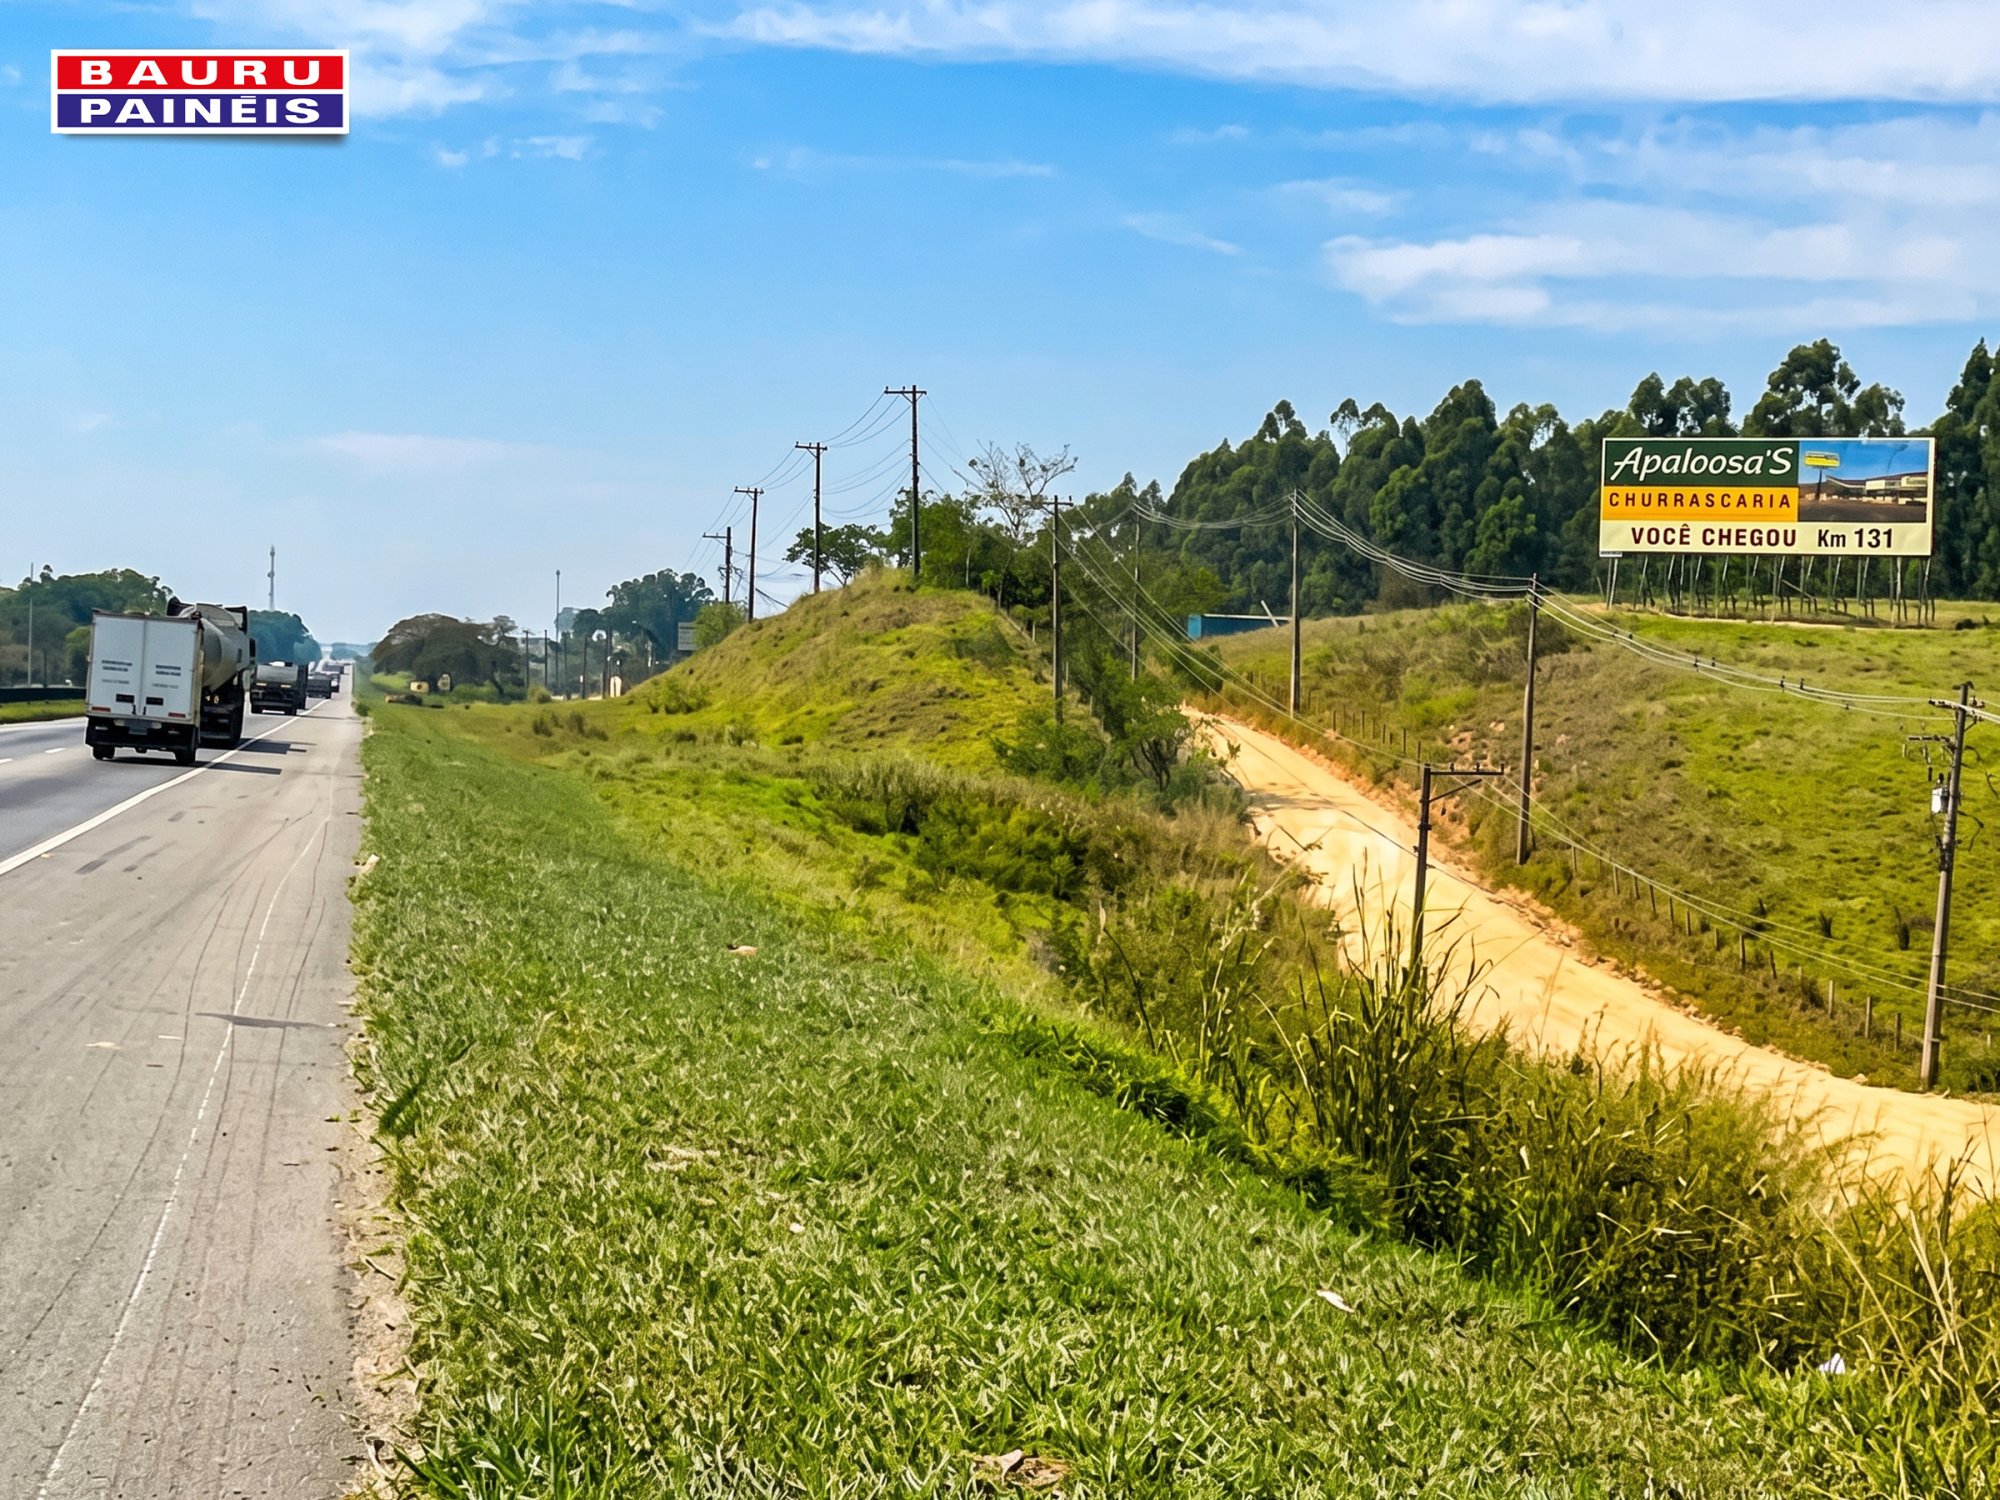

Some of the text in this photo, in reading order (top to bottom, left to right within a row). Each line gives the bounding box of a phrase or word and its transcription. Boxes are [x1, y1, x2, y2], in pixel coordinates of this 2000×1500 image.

[1609, 492, 1791, 509] CHURRASCARIA
[1631, 524, 1893, 549] VOCÊ CHEGOU Km 131
